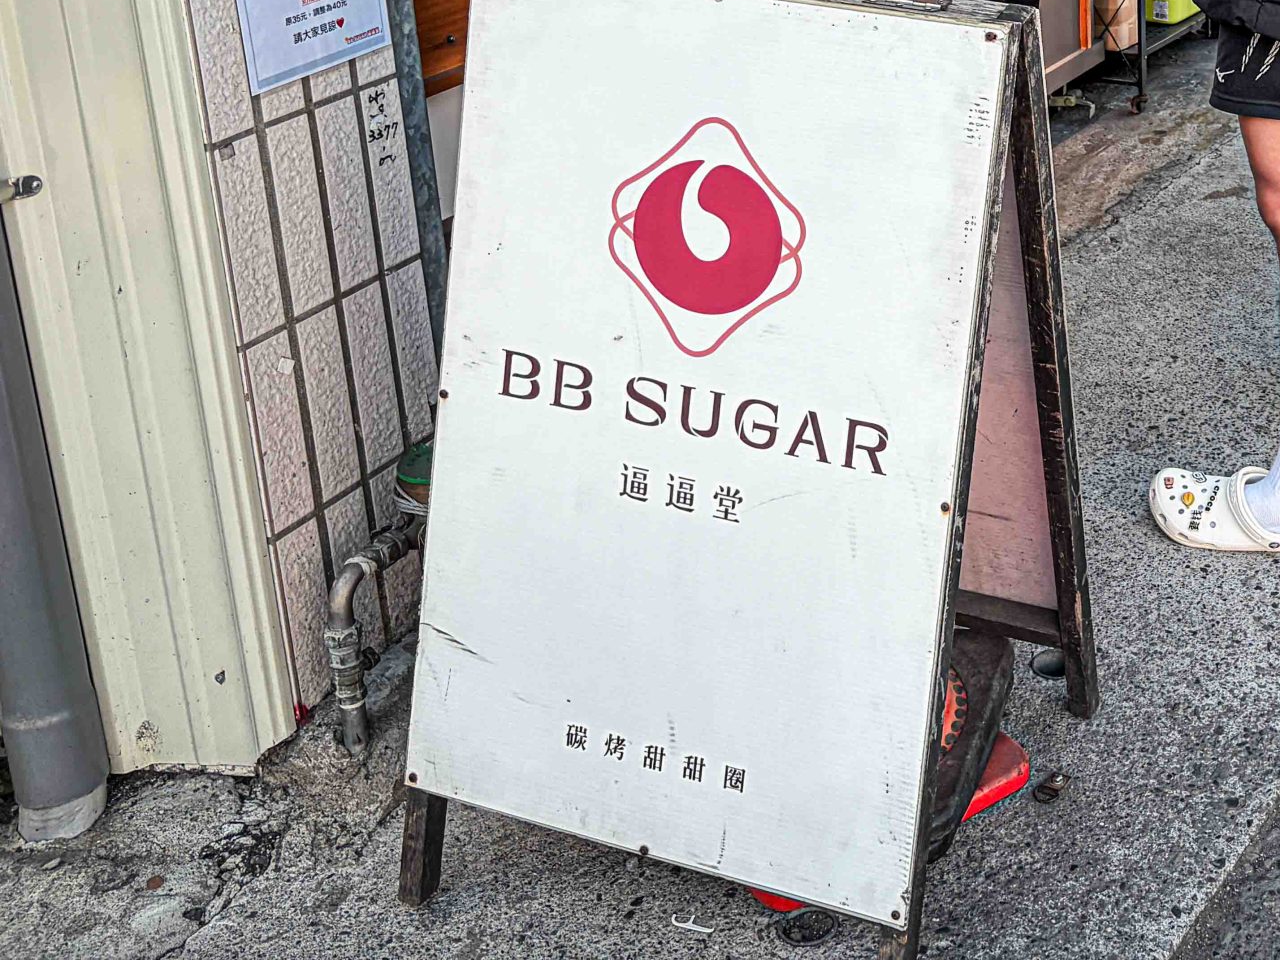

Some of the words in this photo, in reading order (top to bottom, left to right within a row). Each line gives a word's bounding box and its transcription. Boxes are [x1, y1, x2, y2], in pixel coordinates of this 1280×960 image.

[293, 20, 337, 45] 請大家見諒
[498, 348, 593, 411] BB
[624, 376, 889, 477] SUGAR
[619, 463, 745, 524] 逼逼堂
[565, 722, 747, 795] 碳烤甜甜圈
